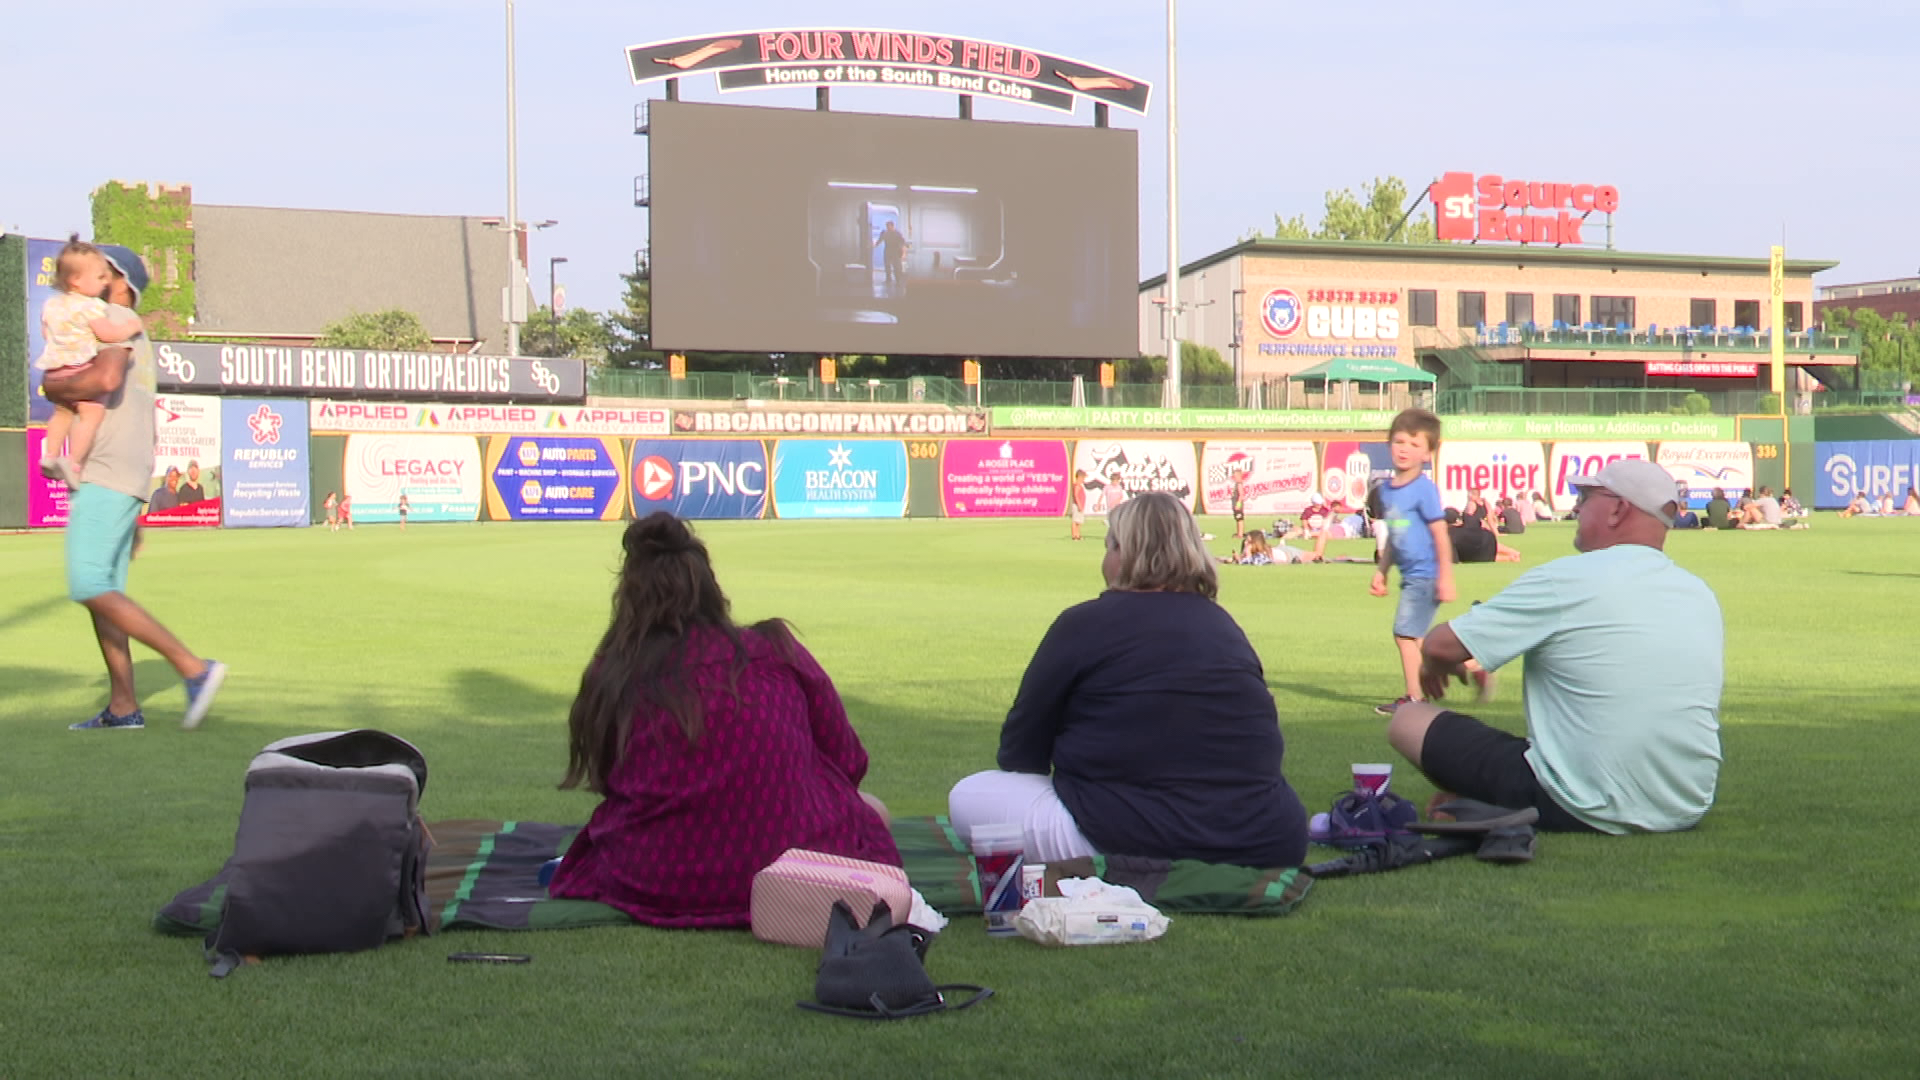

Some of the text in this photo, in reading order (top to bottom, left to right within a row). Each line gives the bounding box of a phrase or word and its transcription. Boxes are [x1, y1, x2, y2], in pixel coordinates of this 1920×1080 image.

[759, 32, 1041, 79] FOUR WINDS FIELD
[765, 66, 1032, 99] Home of the South Bend Cubs
[1477, 174, 1618, 213] Source
[1478, 209, 1583, 244] Bank
[1307, 289, 1398, 304] SOUTH BEND
[1307, 305, 1399, 340] CUBS
[1258, 343, 1397, 357] PERFORMANCE CENTER
[158, 344, 195, 383] SBO
[221, 347, 510, 393] SOUTH BEND ORTHOPAEDICS
[531, 360, 559, 394] SBO
[320, 404, 408, 419] APPLIED
[448, 407, 536, 422] APPLIED
[576, 410, 665, 424] APPLIED
[1092, 411, 1182, 425] PARTY DECK
[695, 411, 968, 433] RBCARCOMPANY.COM
[1195, 413, 1351, 427] www.RiverValleyDecks.com
[1525, 421, 1718, 438] New Homes Additions Decking
[234, 449, 297, 460] REPUBLIC
[542, 448, 597, 461] AUTO PARTS
[911, 442, 938, 458] 360
[382, 459, 465, 475] LEGACY
[1010, 460, 1035, 468] PLACE
[678, 461, 763, 496] PNC
[805, 470, 878, 488] BEACON
[947, 474, 984, 484] Creating
[1123, 477, 1188, 491] TUX SHOP
[1446, 454, 1539, 499] meijer
[1831, 464, 1910, 497] SURF
[545, 486, 595, 499] AUTO CARE
[806, 489, 877, 500] HEALTH SYSTEM
